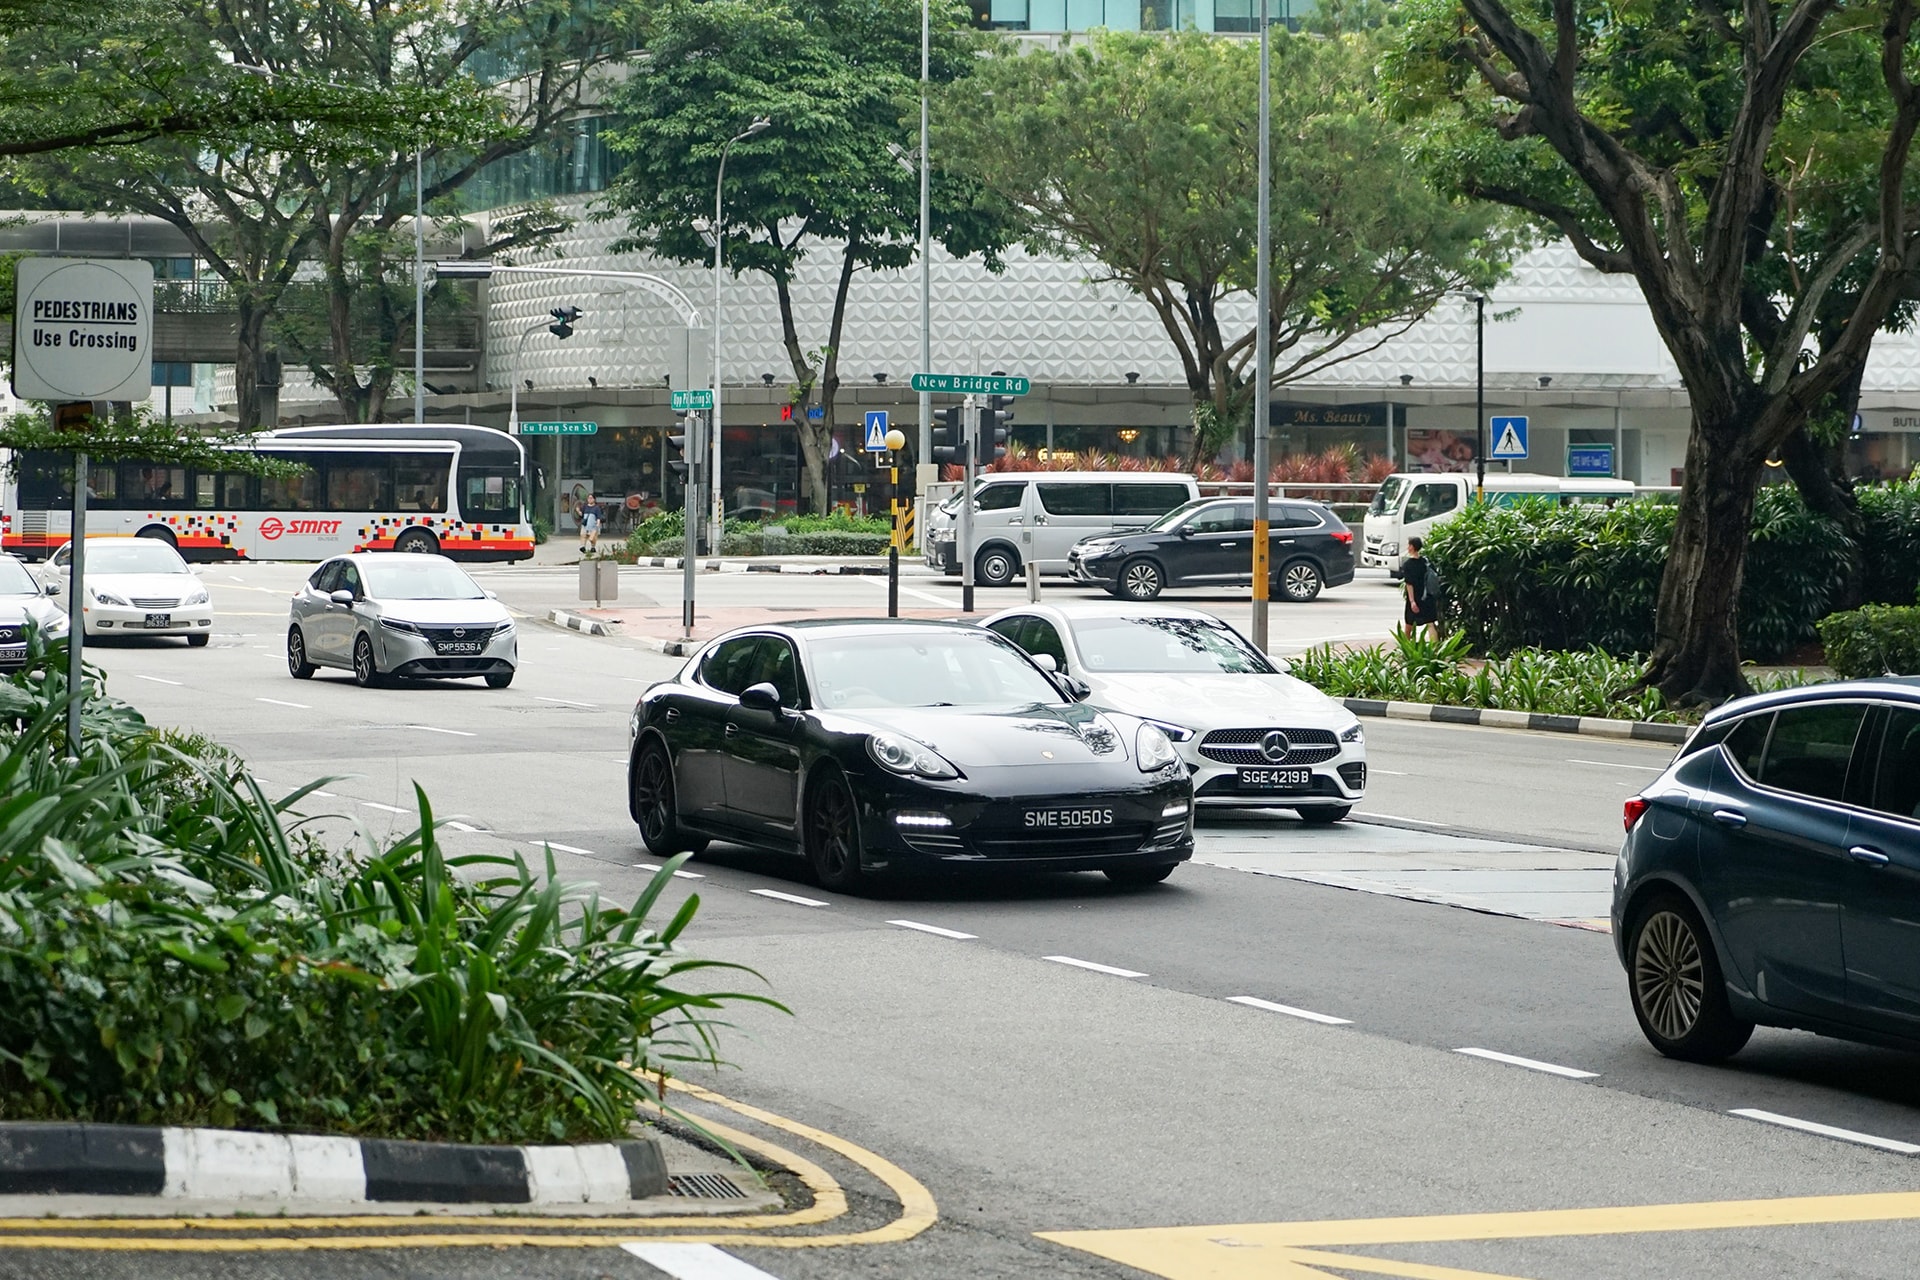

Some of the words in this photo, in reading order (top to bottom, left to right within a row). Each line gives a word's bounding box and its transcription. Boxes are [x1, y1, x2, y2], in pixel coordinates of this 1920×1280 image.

[34, 301, 137, 320] PEDESTRIANS
[33, 329, 61, 347] Use
[69, 330, 137, 352] Crossing
[919, 376, 947, 388] New
[953, 377, 1000, 393] Bridge
[1005, 379, 1022, 391] Rd
[1294, 410, 1319, 423] Ms.
[1322, 410, 1371, 425] Beauty
[523, 423, 535, 432] Eu
[538, 423, 560, 433] Tong
[562, 423, 580, 432] Sen
[582, 423, 593, 432] St
[286, 520, 342, 534] SMRT
